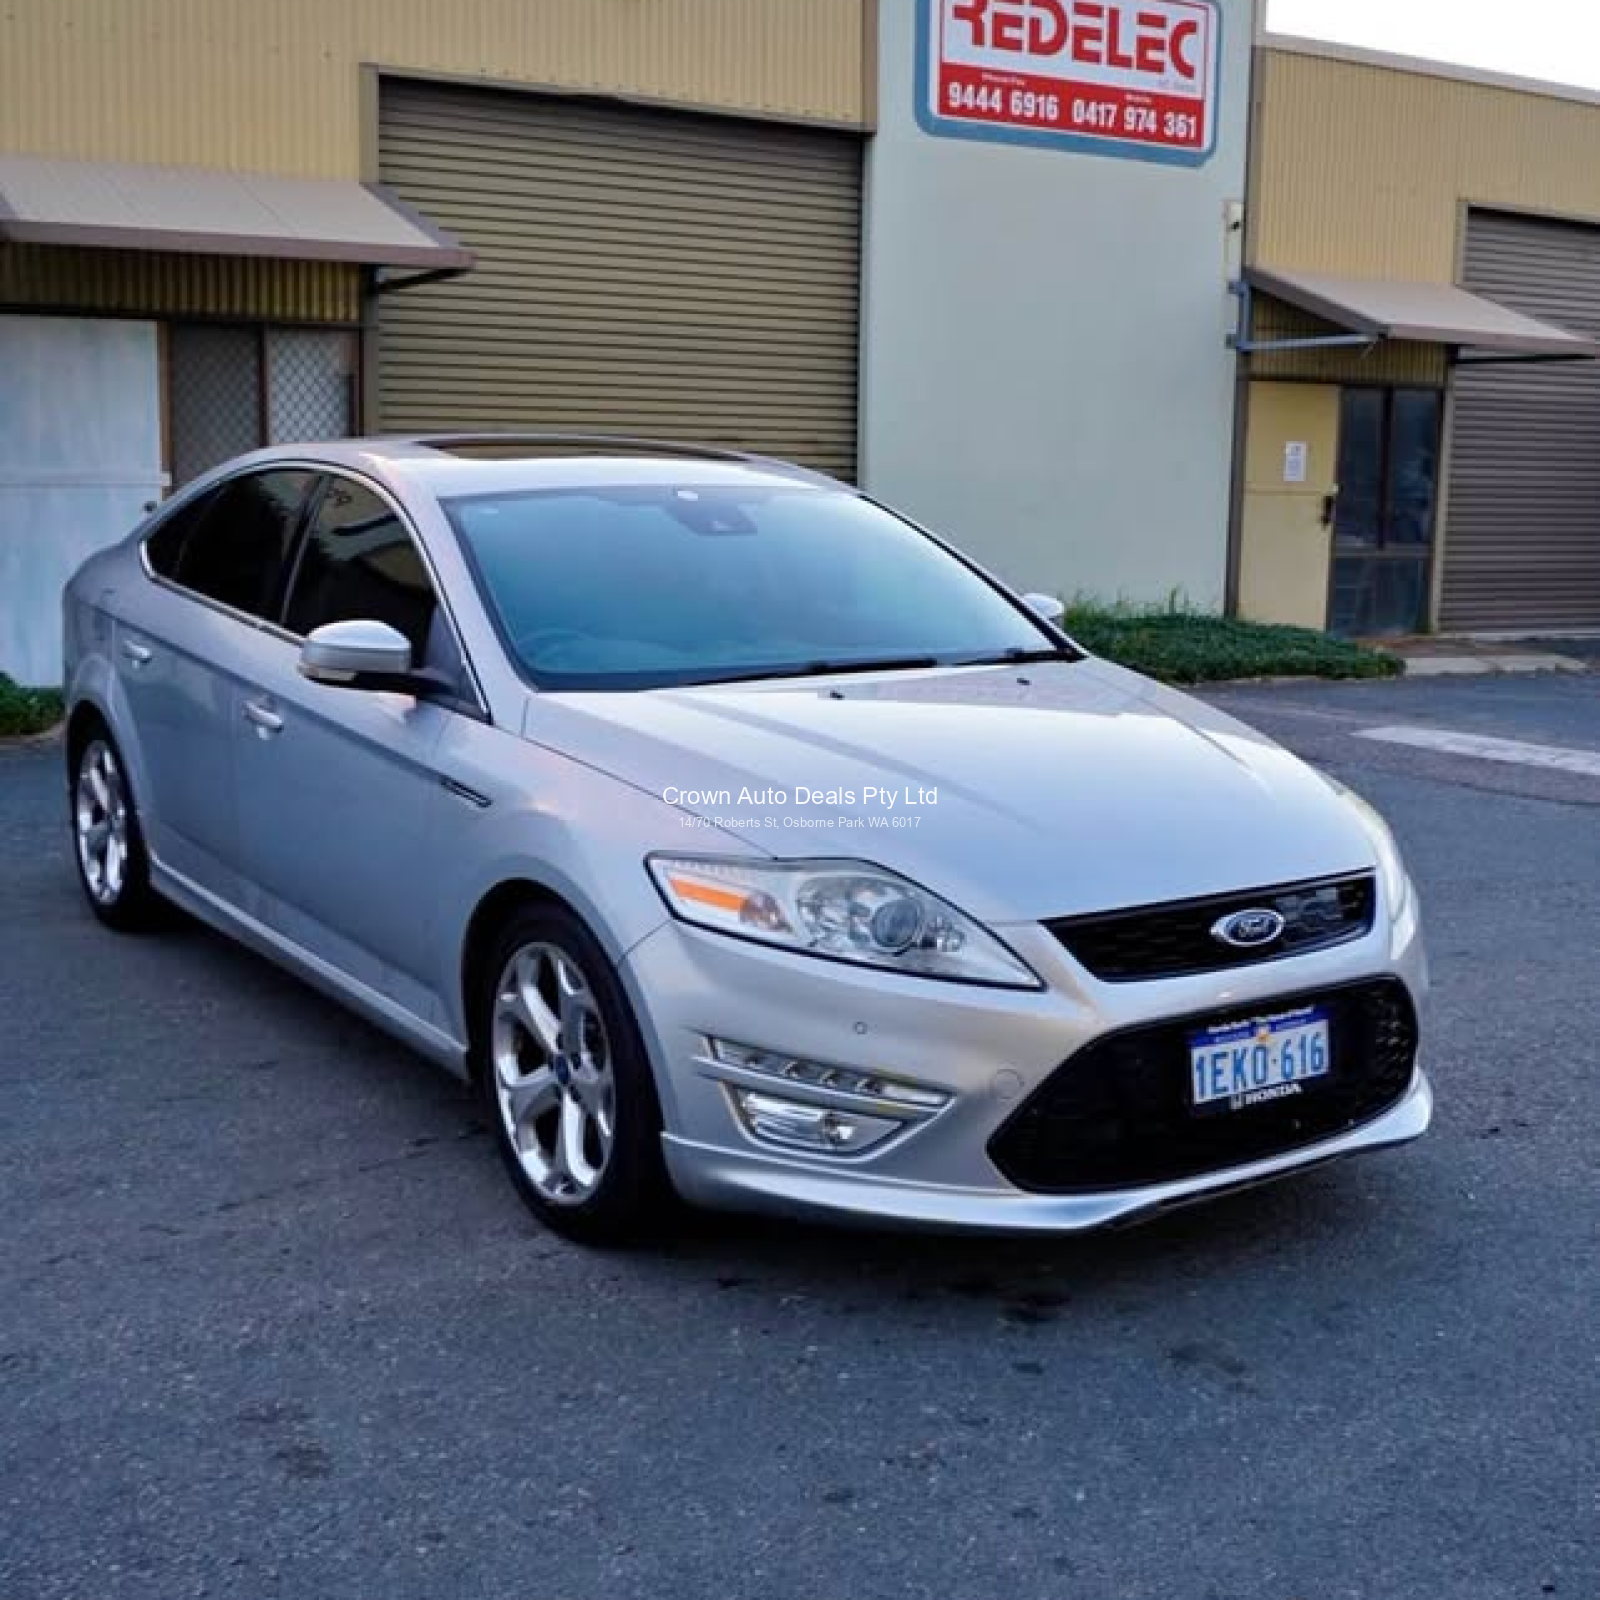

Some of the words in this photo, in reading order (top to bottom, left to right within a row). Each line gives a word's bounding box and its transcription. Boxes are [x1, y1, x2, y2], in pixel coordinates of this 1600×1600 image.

[952, 0, 1198, 80] REDELEC
[948, 81, 1002, 113] 9444
[1009, 91, 1059, 121] 6916
[1072, 99, 1118, 128] 0417
[1123, 106, 1157, 134] 974
